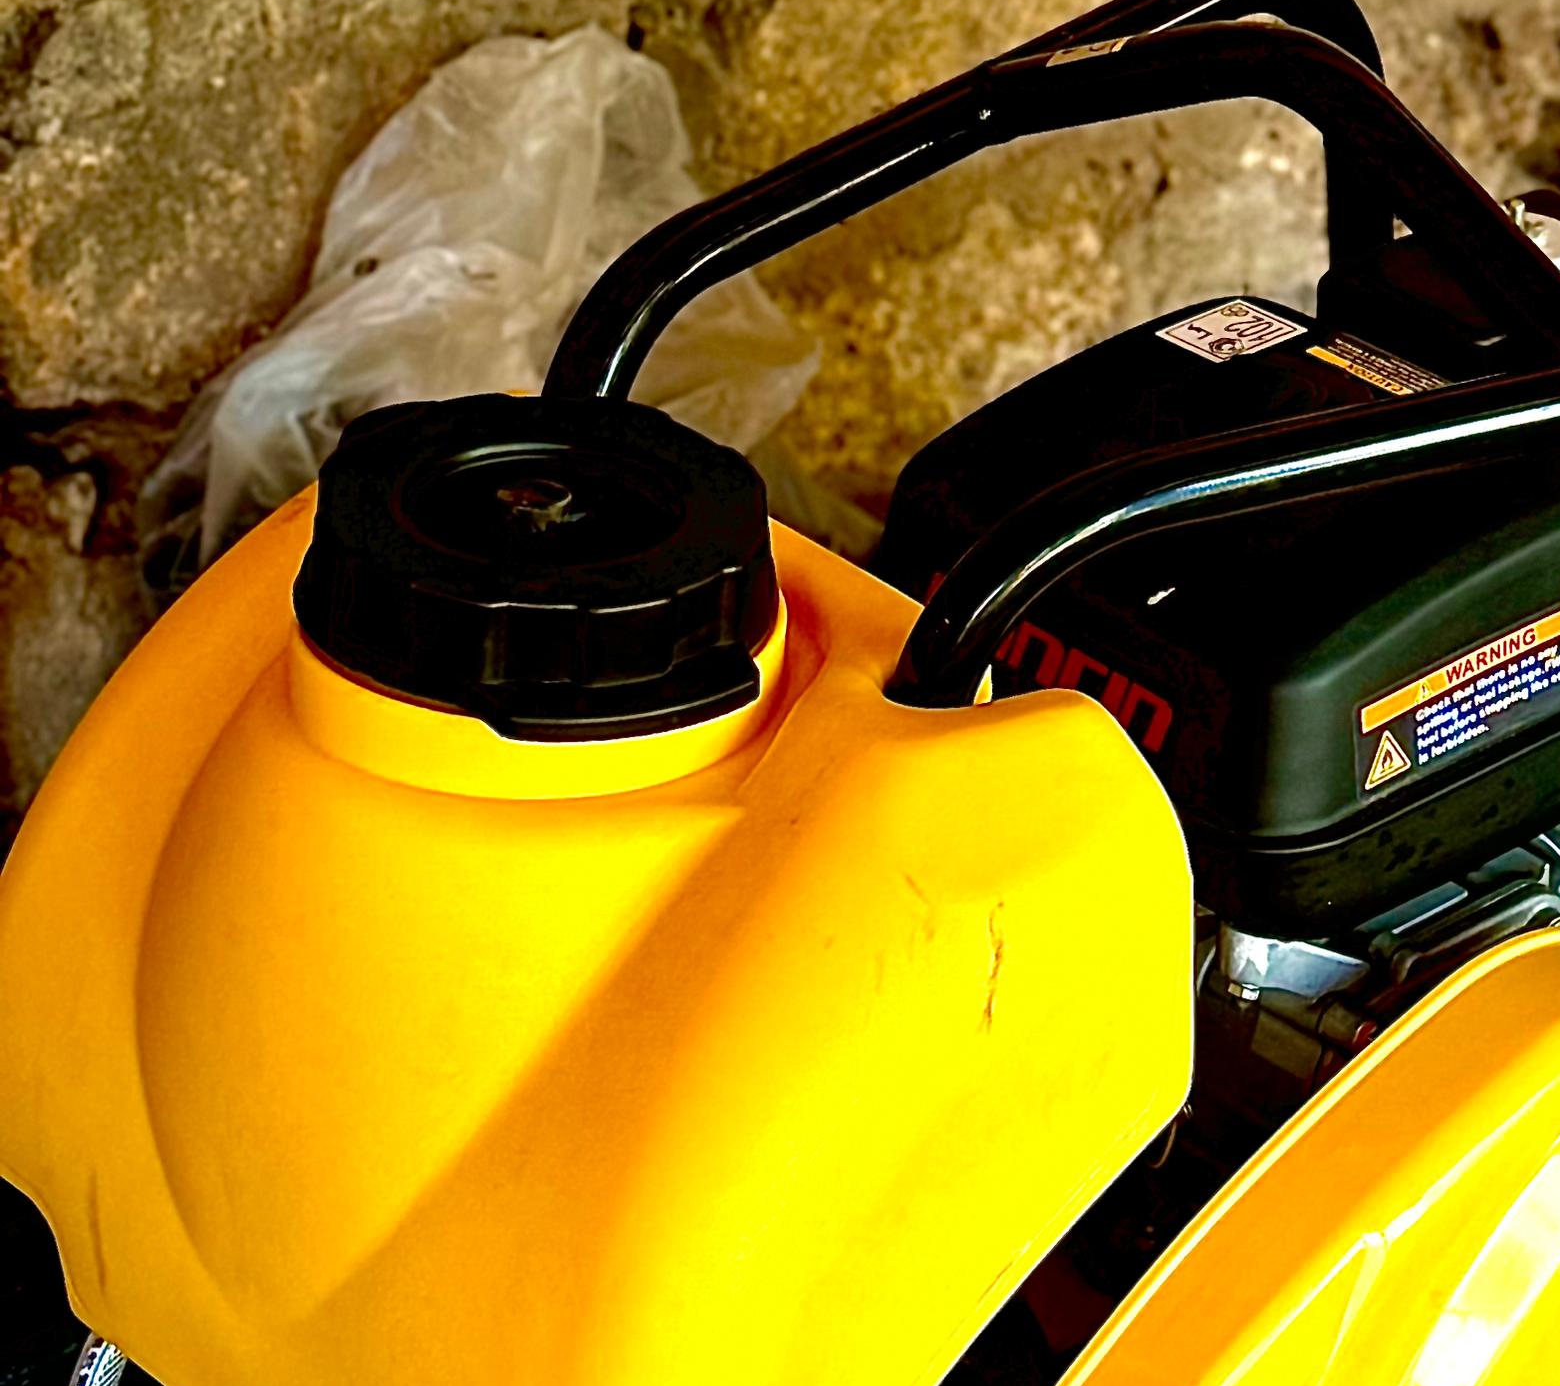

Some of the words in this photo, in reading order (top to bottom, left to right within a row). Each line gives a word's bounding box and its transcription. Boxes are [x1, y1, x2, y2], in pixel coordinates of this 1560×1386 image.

[1223, 315, 1284, 342] 102
[1446, 628, 1537, 683] WARNING
[1416, 697, 1451, 721] Check
[1453, 684, 1475, 702] that
[1477, 669, 1505, 690] there
[1508, 663, 1518, 676] is
[1521, 656, 1535, 669] no
[1461, 700, 1472, 713] or
[1474, 686, 1496, 706] fuel
[1417, 731, 1439, 750] fuel
[1441, 713, 1477, 738] before
[1479, 687, 1529, 719] stopping
[1531, 678, 1549, 693] the
[1418, 753, 1429, 765] is
[1431, 724, 1490, 758] forbidden.
